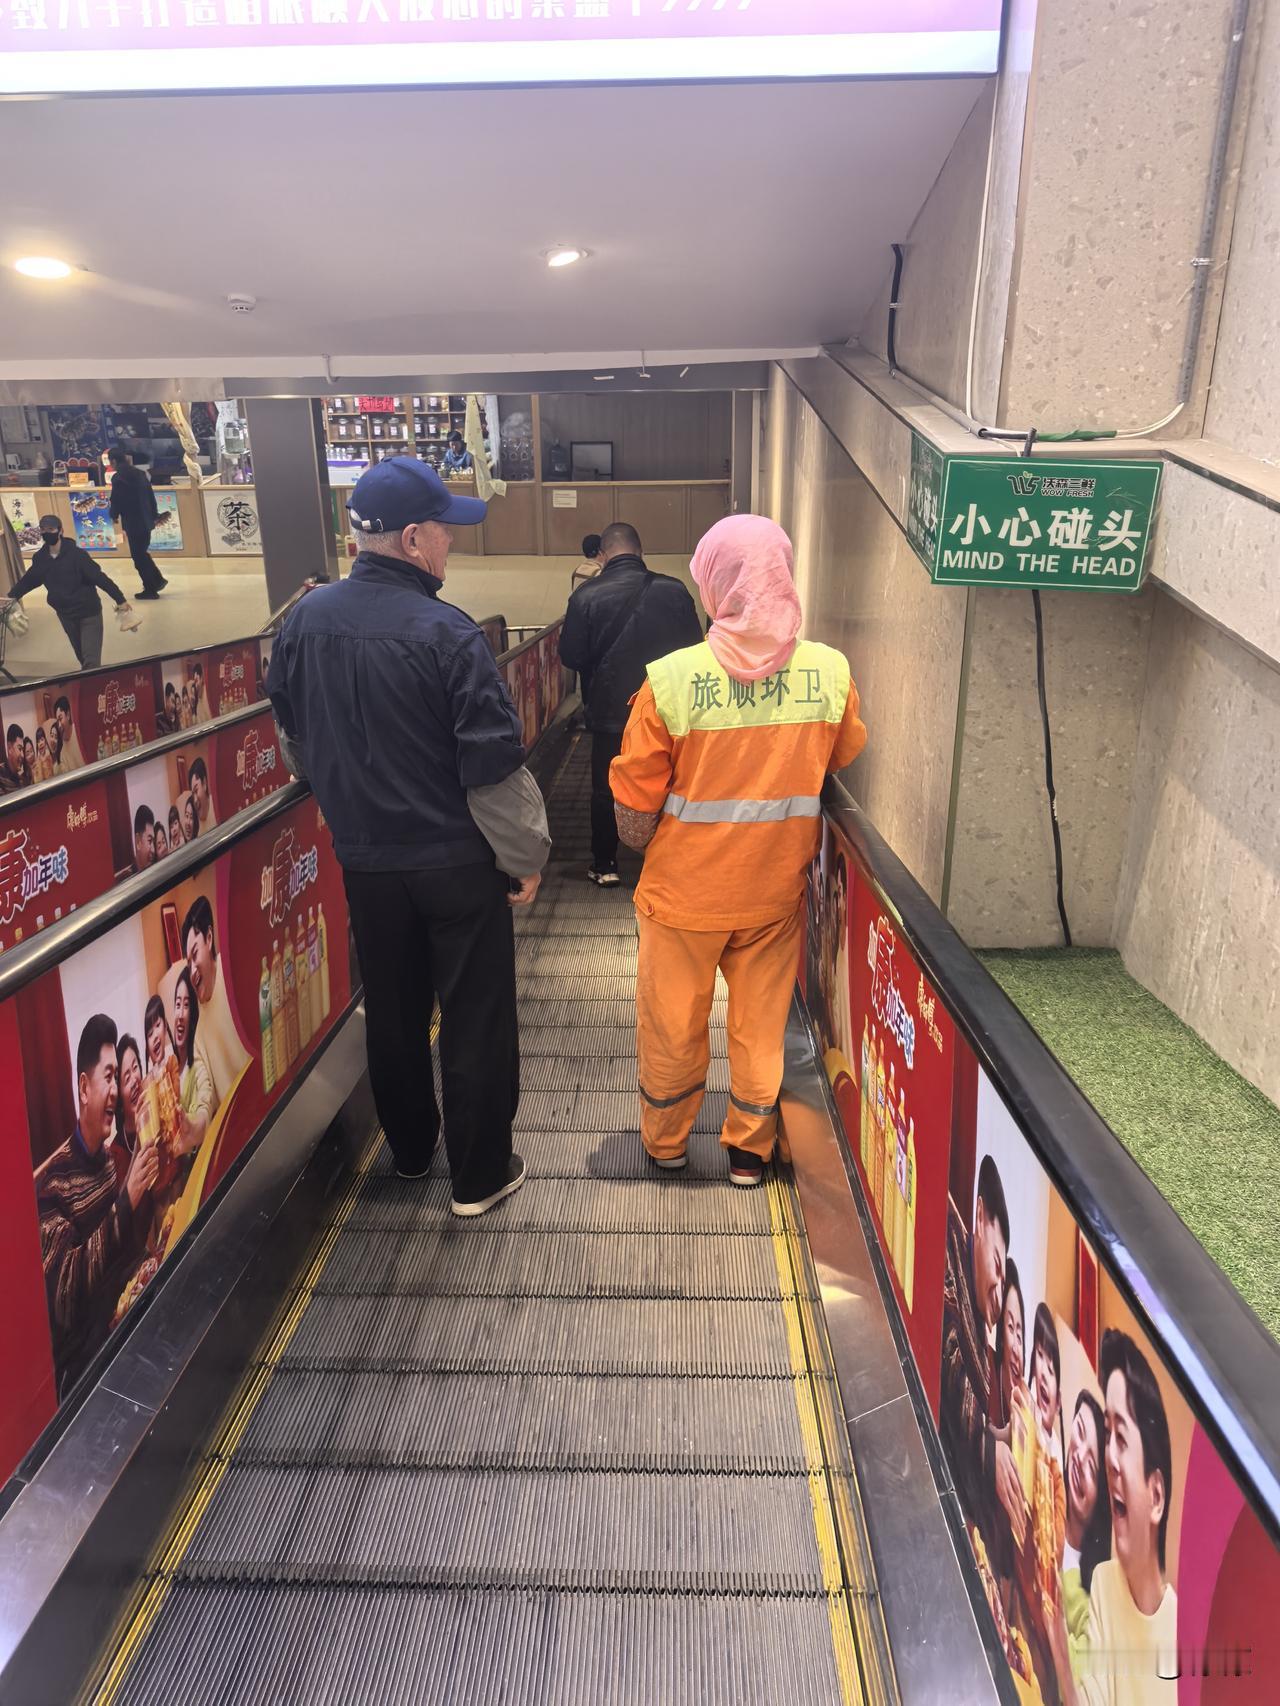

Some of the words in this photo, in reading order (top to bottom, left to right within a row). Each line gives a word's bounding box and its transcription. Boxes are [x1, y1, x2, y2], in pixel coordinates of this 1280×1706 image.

[1042, 477, 1096, 489] 沃森三鲜
[223, 501, 252, 530] 茶
[948, 503, 1142, 551] 小心碰头
[943, 550, 1005, 570] MIND
[1016, 553, 1060, 573] THE
[1071, 556, 1136, 576] HEAD
[691, 668, 823, 710] 旅顺环卫
